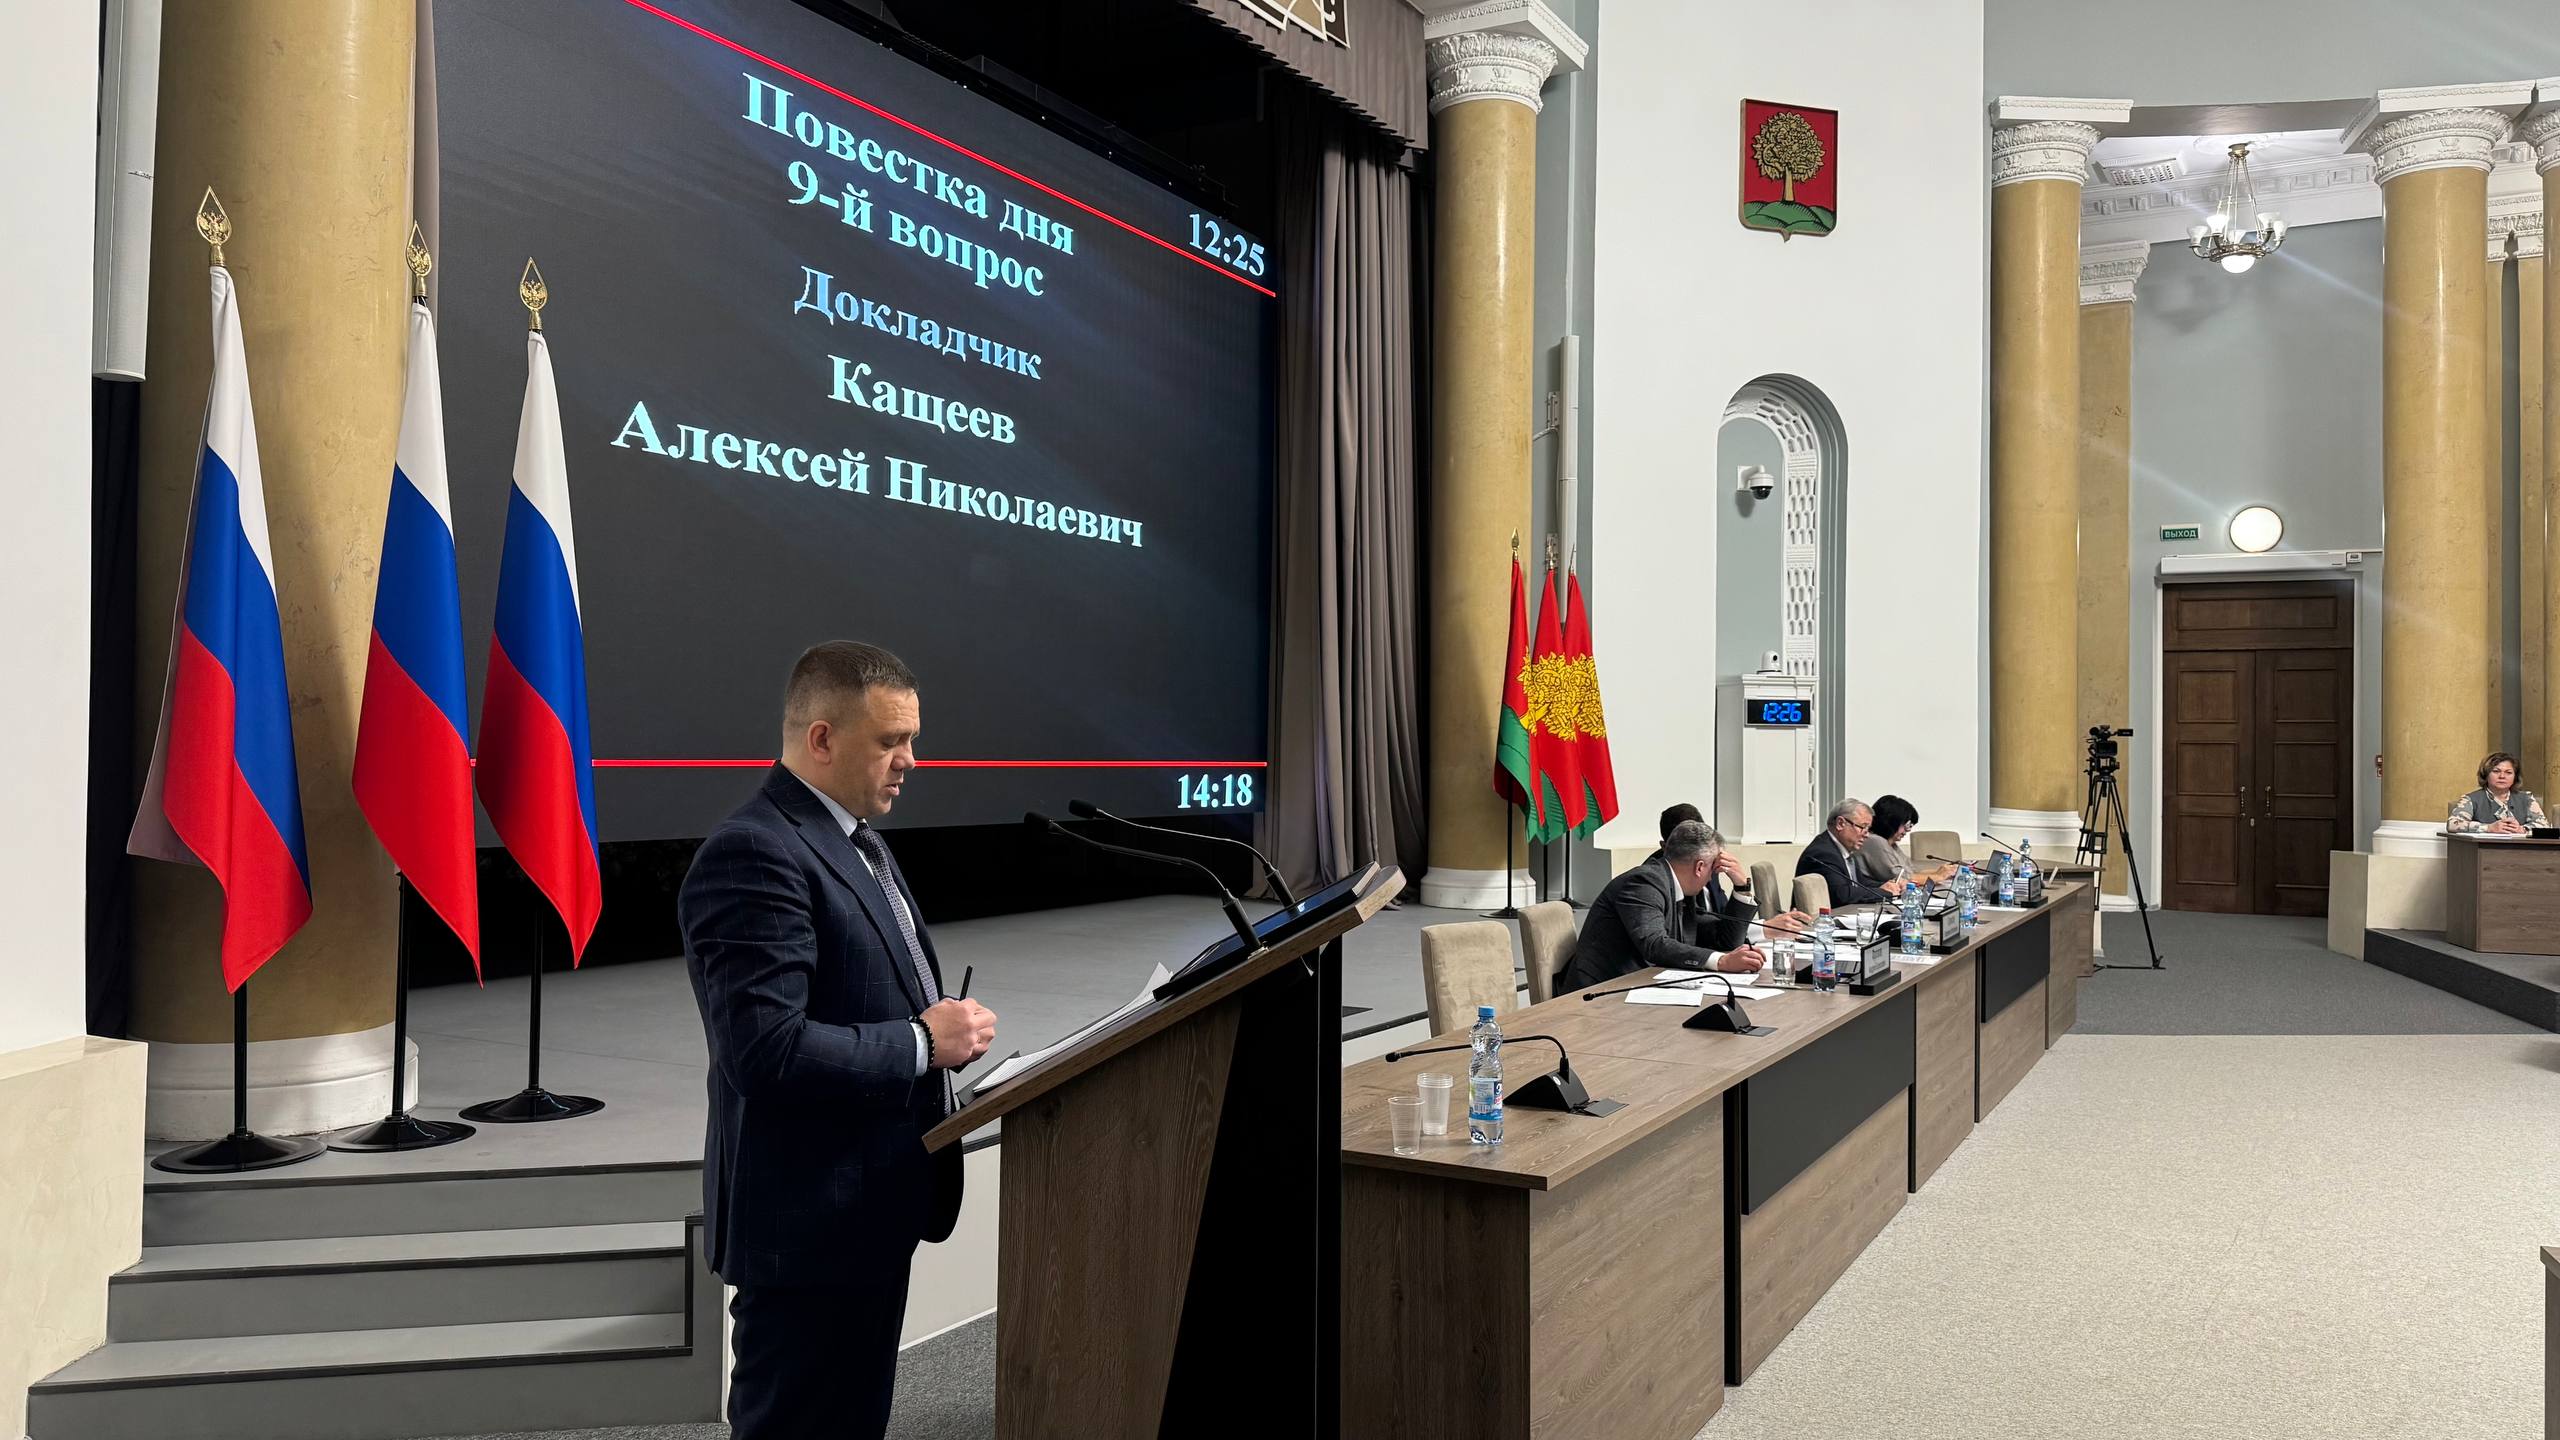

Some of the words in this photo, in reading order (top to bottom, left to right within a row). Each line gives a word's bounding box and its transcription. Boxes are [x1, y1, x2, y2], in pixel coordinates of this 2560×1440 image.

[741, 71, 989, 220] Повестка
[998, 198, 1075, 256] дня
[787, 160, 875, 234] 9-й
[888, 209, 1045, 297] вопрос
[1189, 212, 1266, 278] 12:25
[793, 265, 1042, 381] Докладчик
[827, 354, 1017, 444] Кащеев
[610, 400, 871, 496] Алексей
[884, 455, 1144, 549] Николаевич
[2165, 530, 2196, 538] ВЫХОД
[1763, 702, 1802, 722] 12:26
[1177, 773, 1254, 809] 14:18
